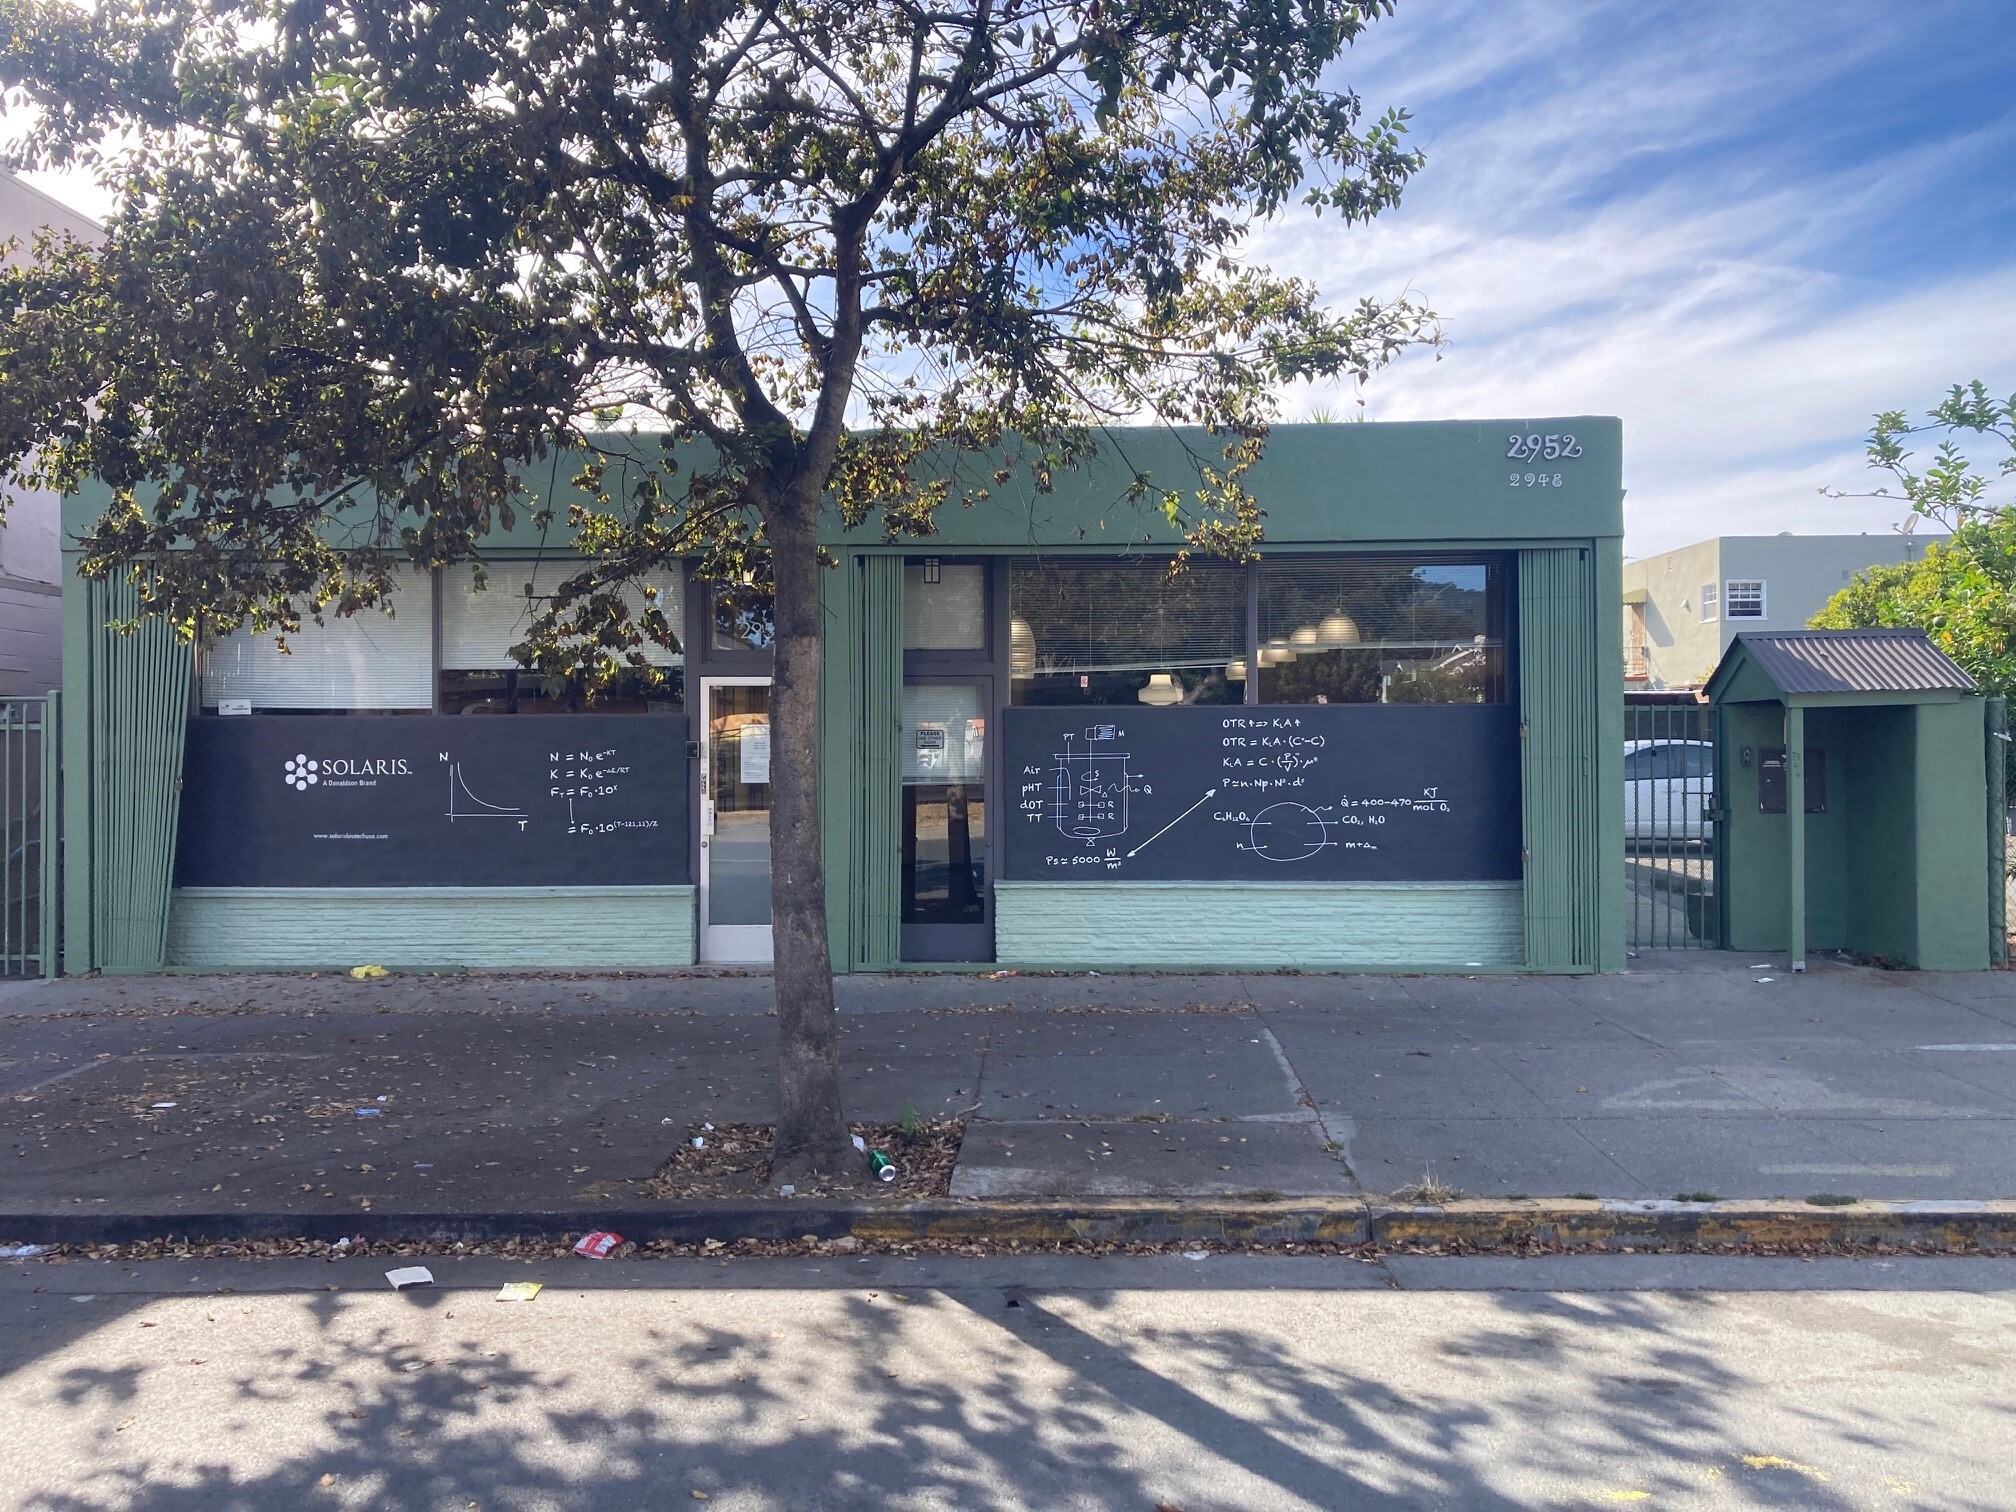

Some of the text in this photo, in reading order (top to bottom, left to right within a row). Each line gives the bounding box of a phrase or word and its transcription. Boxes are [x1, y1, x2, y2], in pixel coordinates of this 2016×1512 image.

[1507, 434, 1583, 463] 2952
[1509, 473, 1563, 487] 2948
[1222, 719, 1246, 728] OTR
[1222, 737, 1246, 747] OTR
[439, 751, 448, 761] N
[550, 752, 559, 762] N
[550, 769, 559, 780] K
[1023, 766, 1040, 775] Air
[1021, 783, 1042, 798] pHT
[1026, 813, 1043, 823] TT
[517, 820, 528, 832] T
[1071, 856, 1101, 865] 5000
